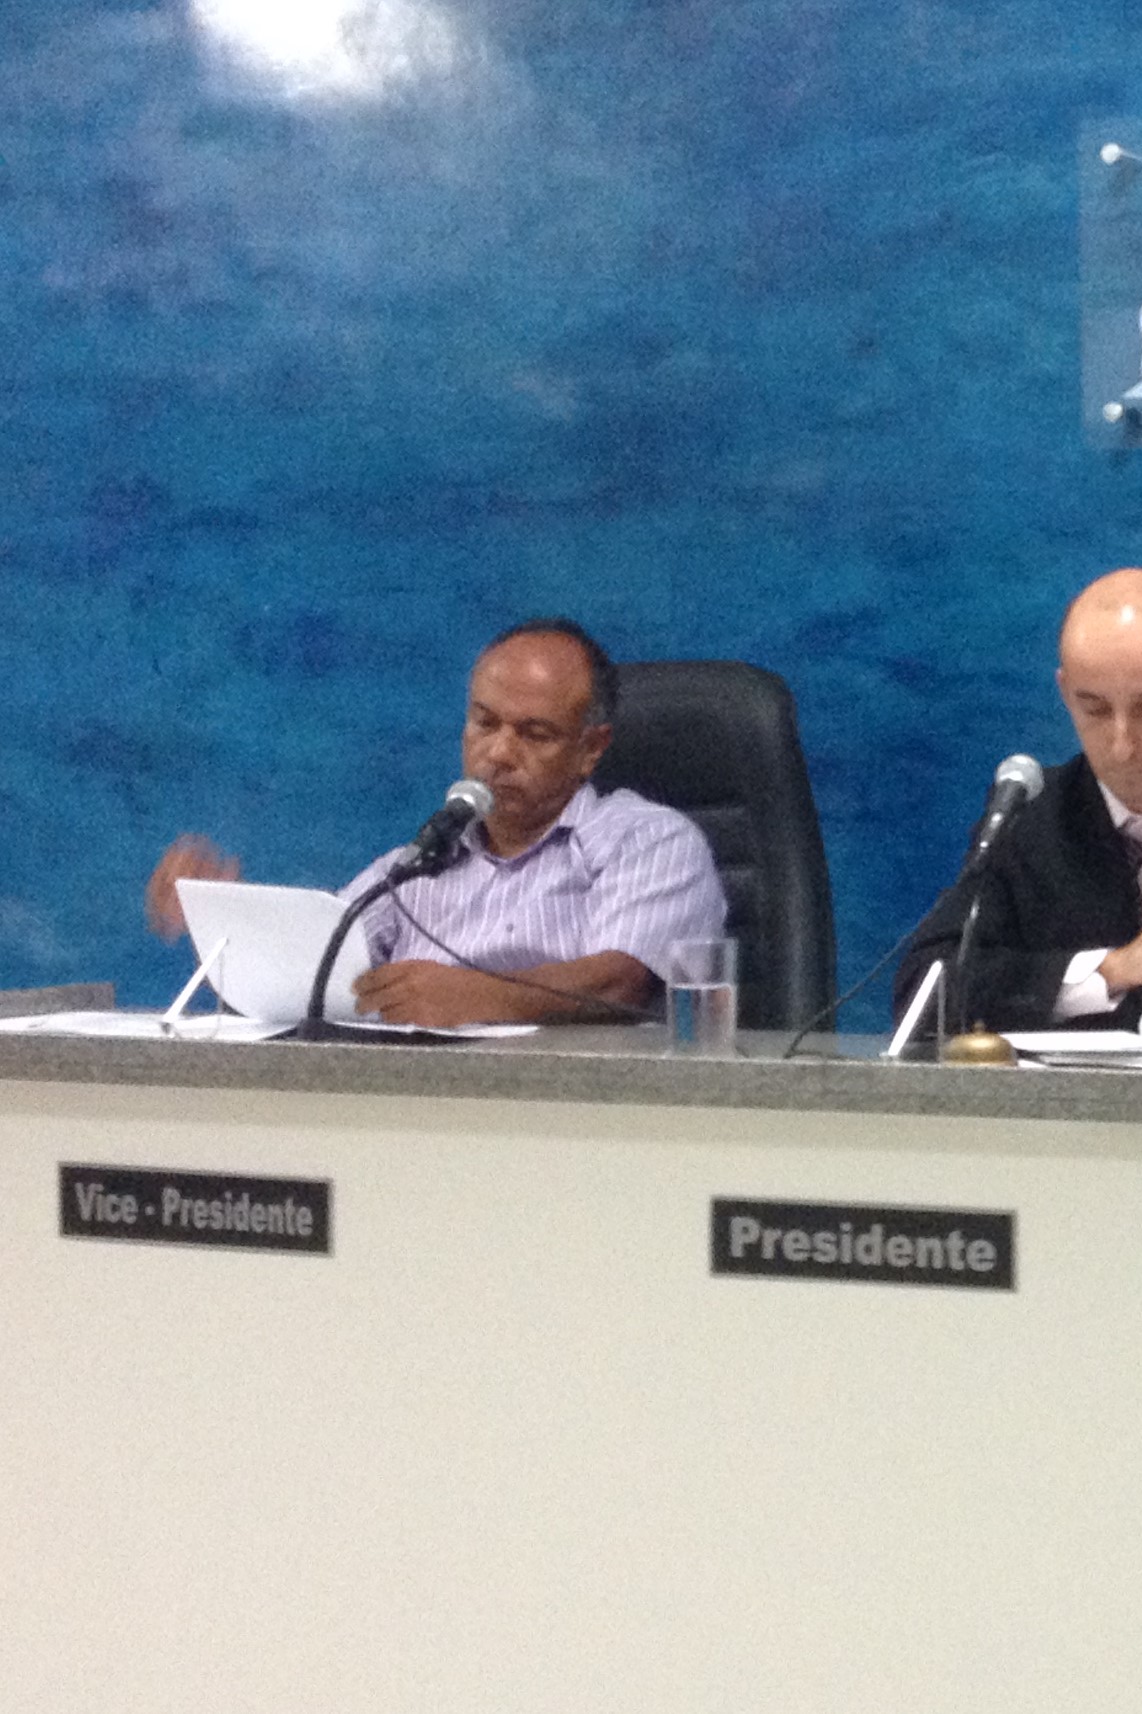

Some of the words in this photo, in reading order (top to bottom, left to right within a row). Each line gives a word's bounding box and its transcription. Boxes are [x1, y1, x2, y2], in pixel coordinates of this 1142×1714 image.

[74, 1182, 139, 1224] Vice
[160, 1186, 314, 1237] Presidente
[728, 1215, 998, 1273] Presidente
